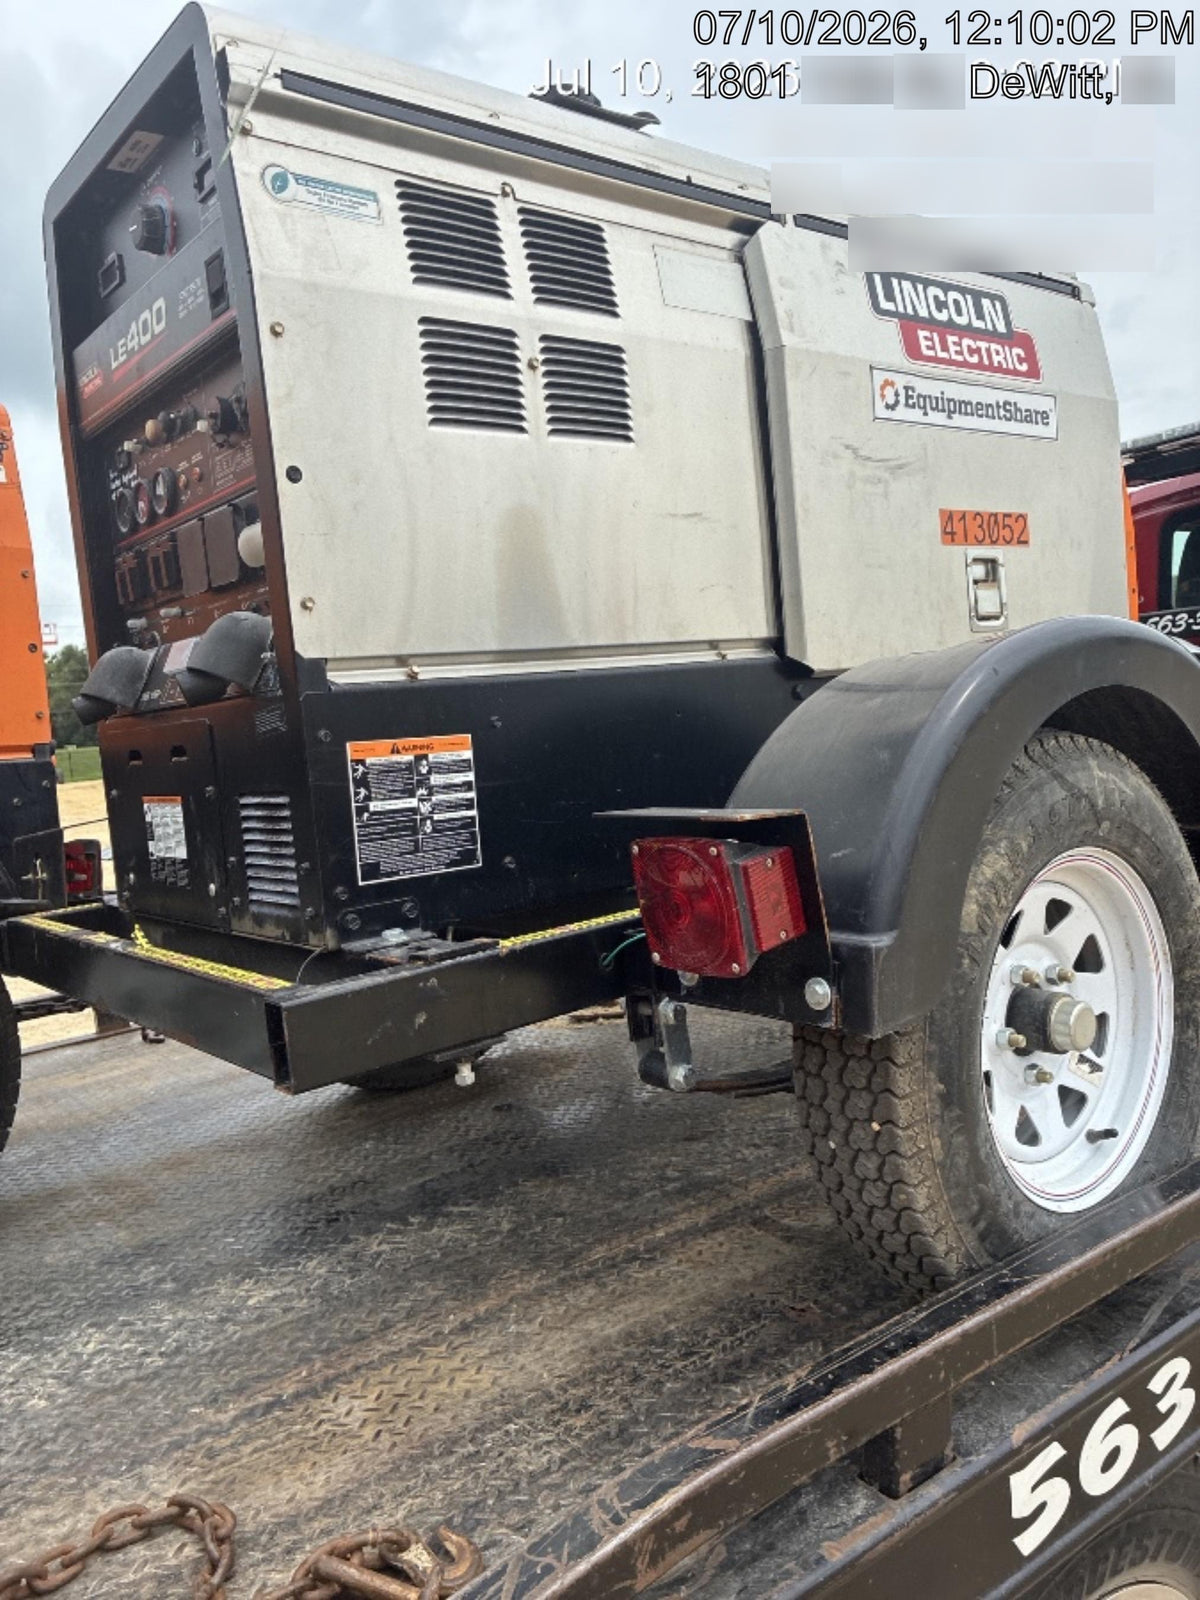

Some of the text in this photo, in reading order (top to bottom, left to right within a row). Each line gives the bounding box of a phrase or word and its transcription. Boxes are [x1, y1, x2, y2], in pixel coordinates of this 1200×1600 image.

[872, 273, 1007, 333] LINCOLN
[109, 296, 167, 370] LE400
[916, 328, 1029, 373] ELECTRIC
[903, 384, 1051, 427] EquipmentShare
[943, 510, 1029, 545] 413052
[1009, 1356, 1196, 1557] 563
